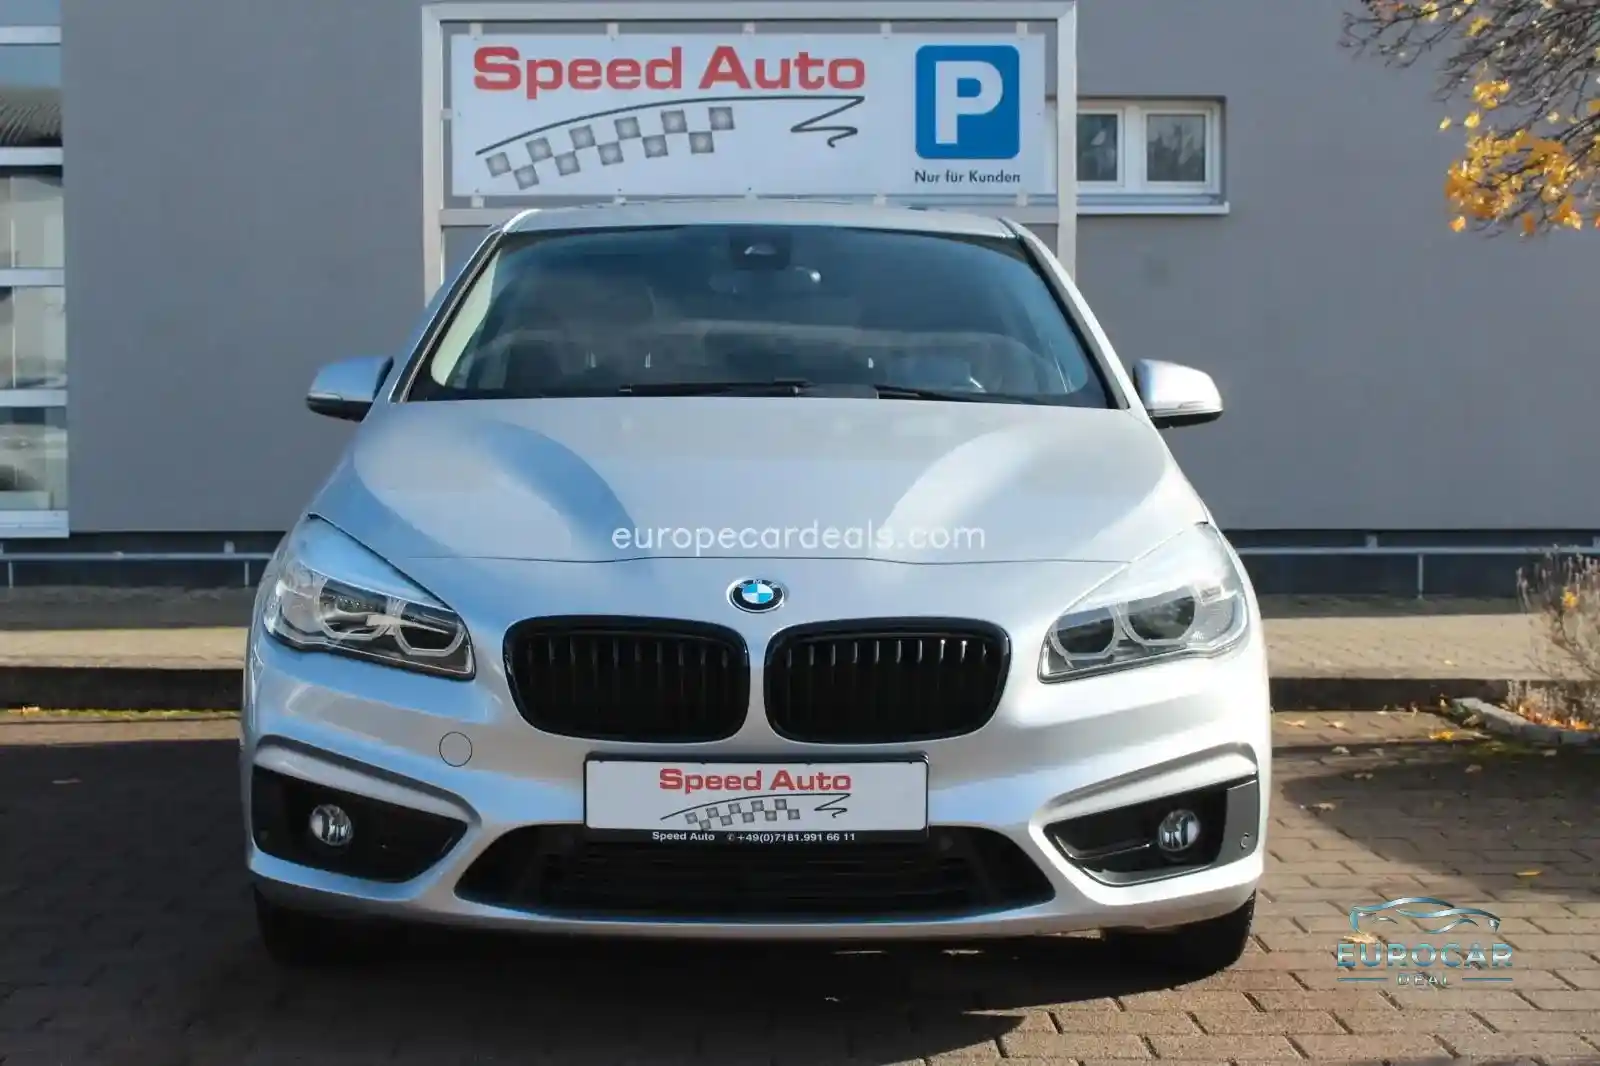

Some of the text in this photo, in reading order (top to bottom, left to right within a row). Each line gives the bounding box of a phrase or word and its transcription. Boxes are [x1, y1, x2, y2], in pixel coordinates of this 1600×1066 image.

[473, 46, 866, 100] Speed Auto
[935, 61, 1003, 144] P
[914, 168, 1021, 183] Nur für Kunden
[659, 768, 851, 794] Speed Auto
[651, 831, 687, 842] Speed
[689, 832, 715, 842] Auto
[826, 832, 840, 842] 66
[843, 832, 856, 842] 11
